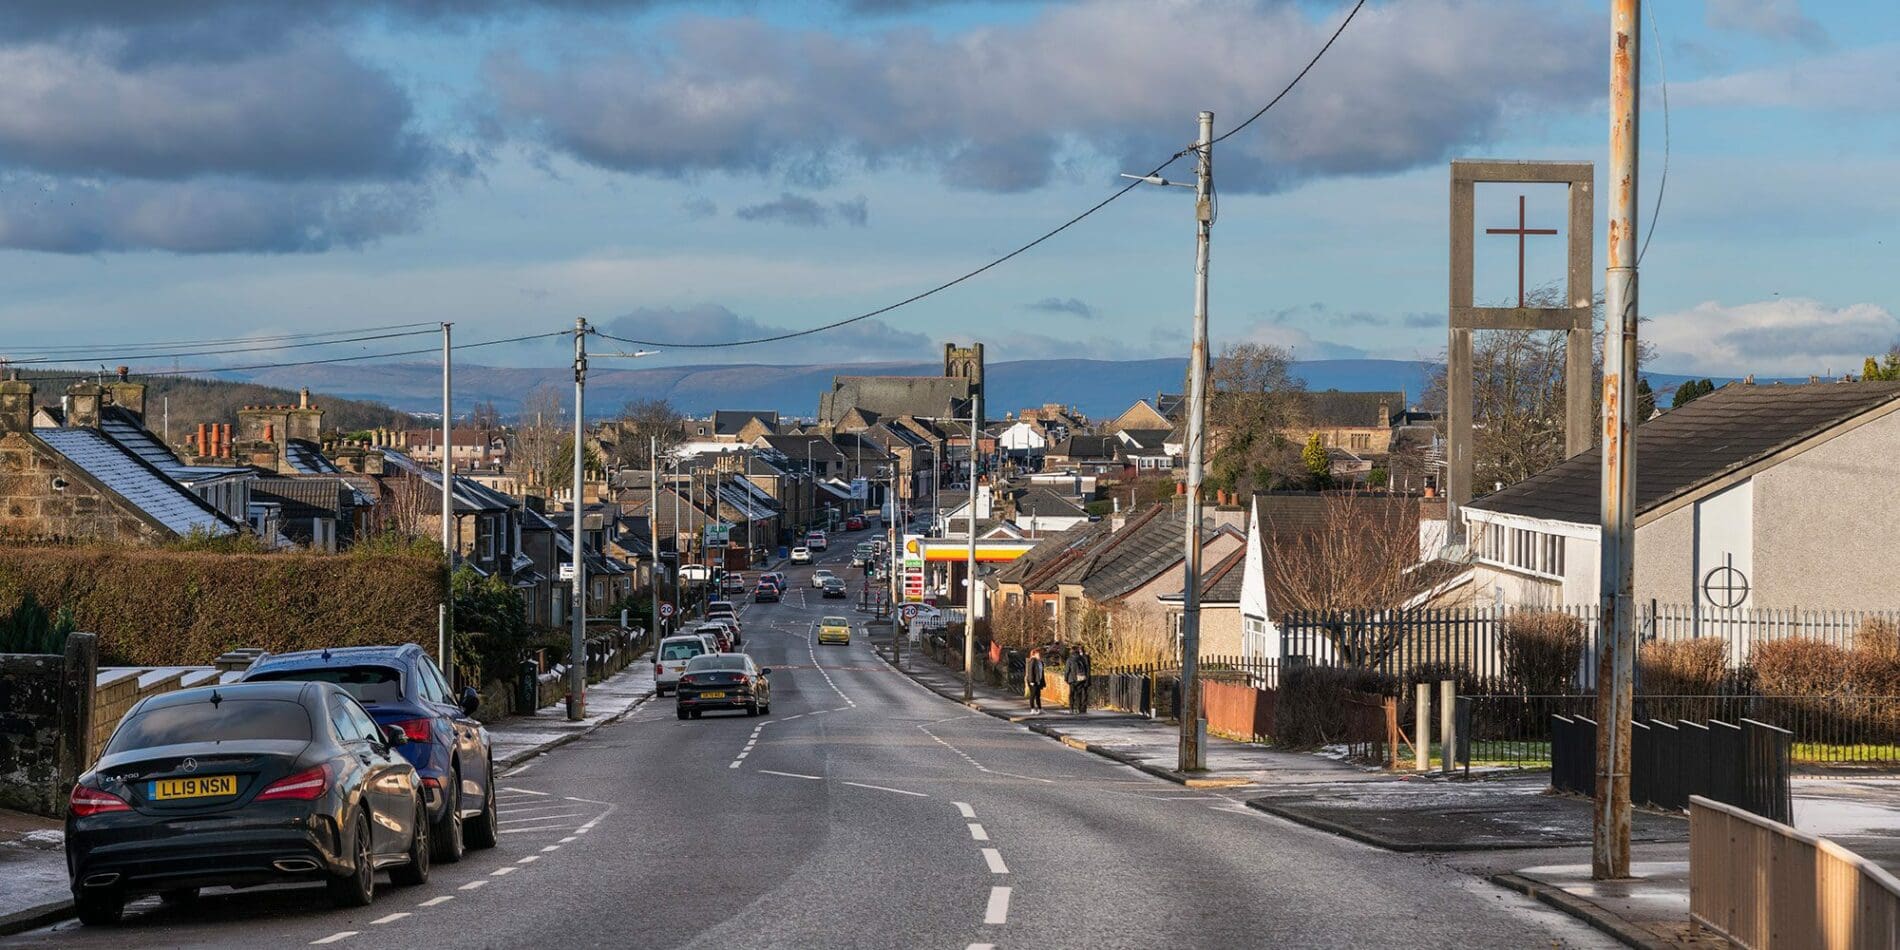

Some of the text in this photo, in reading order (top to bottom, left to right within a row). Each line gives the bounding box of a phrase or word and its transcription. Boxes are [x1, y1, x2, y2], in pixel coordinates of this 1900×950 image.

[105, 772, 139, 783] CLA 200
[162, 778, 230, 797] LL19 NSN
